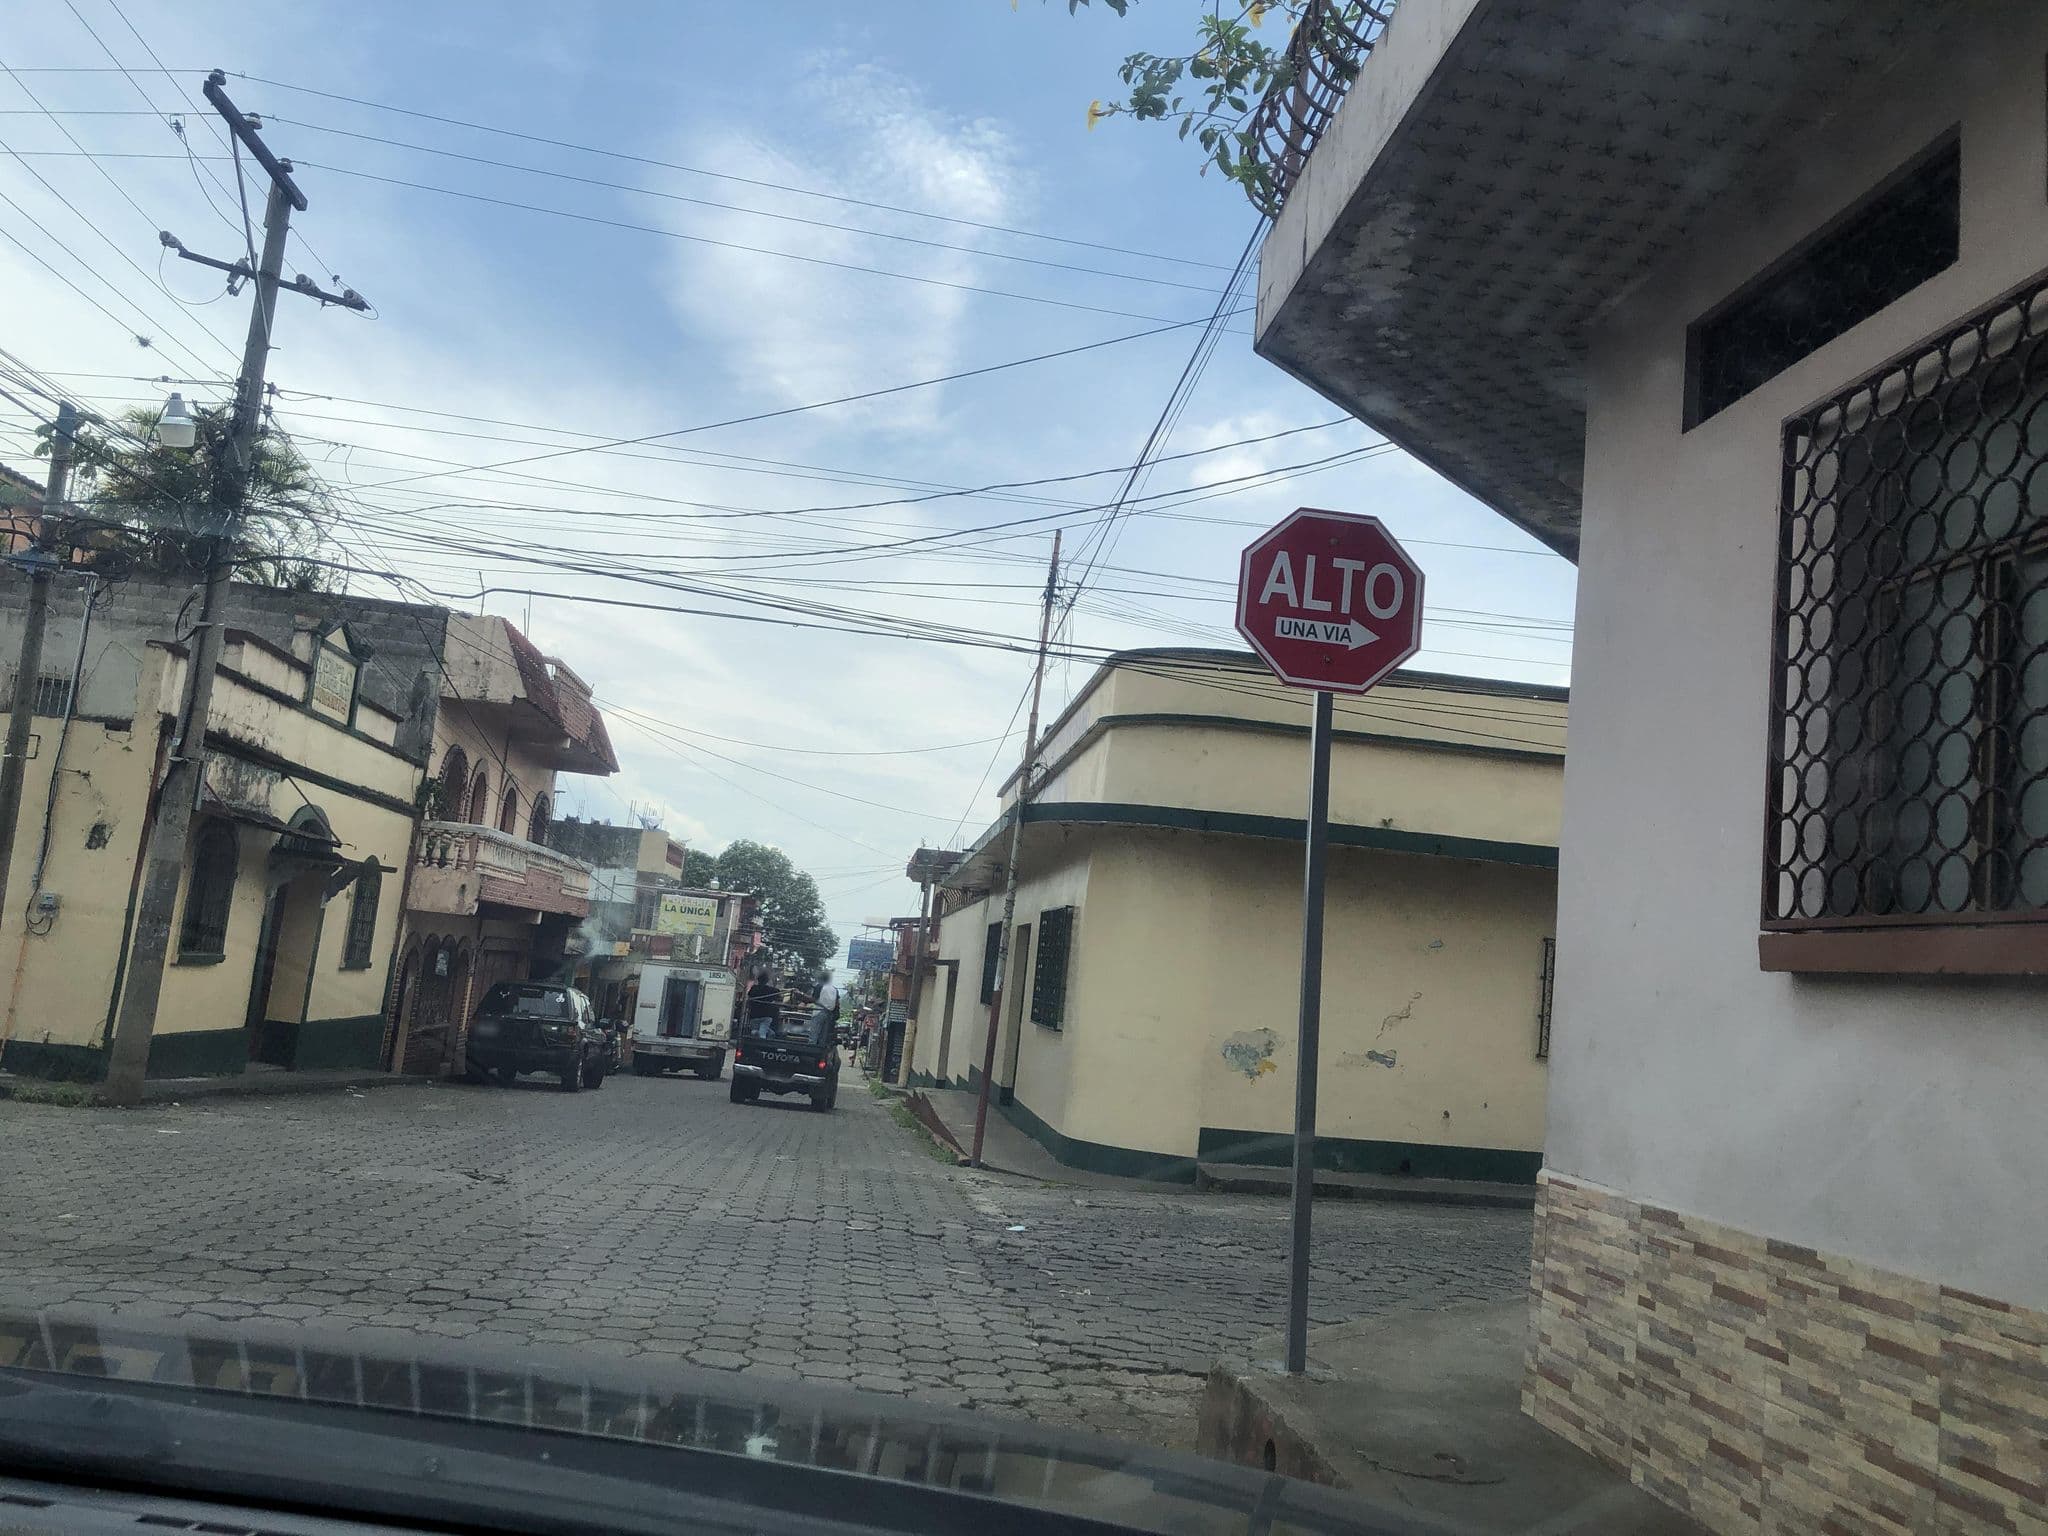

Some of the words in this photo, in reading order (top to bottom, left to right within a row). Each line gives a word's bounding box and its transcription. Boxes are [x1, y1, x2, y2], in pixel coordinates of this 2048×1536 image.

[1259, 550, 1404, 620] ALTO
[1280, 619, 1318, 640] UNA
[1323, 624, 1353, 643] VIA
[664, 904, 677, 912] LA
[680, 905, 711, 916] UNICA
[761, 1051, 800, 1063] TOYOTA
